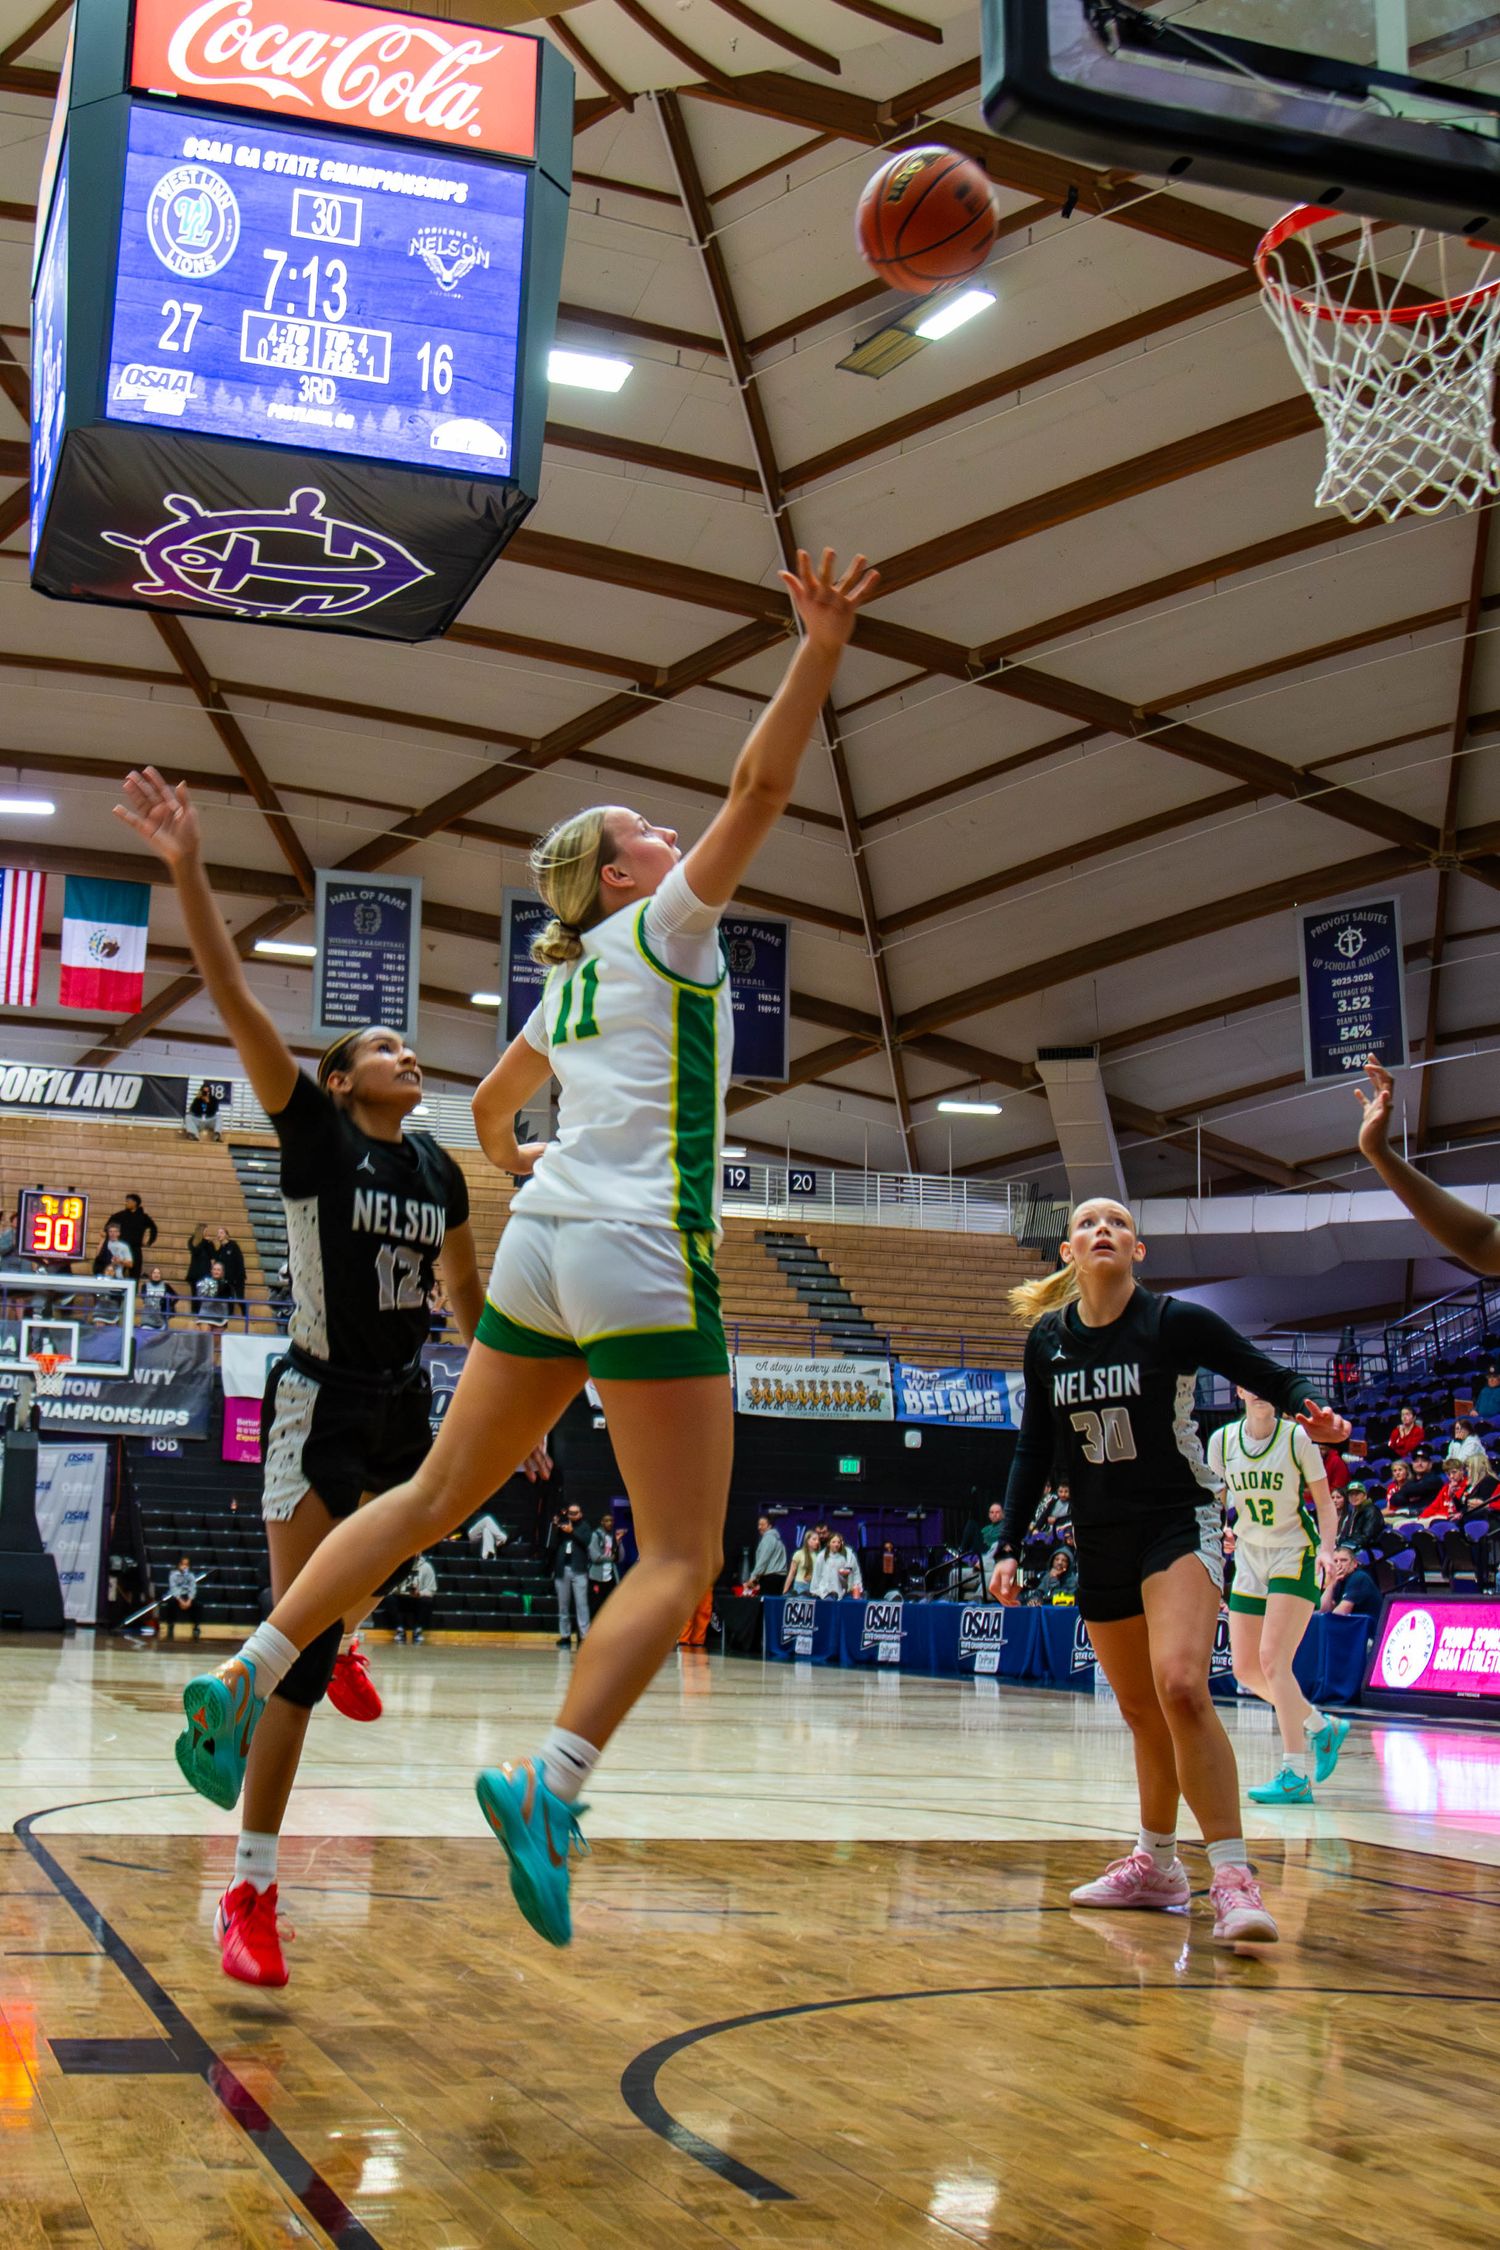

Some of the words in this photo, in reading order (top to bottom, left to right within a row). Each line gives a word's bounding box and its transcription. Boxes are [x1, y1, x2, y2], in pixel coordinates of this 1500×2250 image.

[168, 0, 504, 131] Coca-Cola
[263, 151, 320, 179] STATE
[311, 197, 342, 237] 30
[166, 248, 217, 273] LIONS
[408, 236, 490, 269] NELSON
[263, 248, 348, 322] 7:13
[158, 299, 203, 353] 27
[125, 368, 188, 391] OSAA
[417, 341, 453, 395] 16
[298, 375, 336, 405] 3RD
[329, 891, 357, 905] HALL
[360, 891, 375, 900] OF
[378, 892, 407, 911] FAME
[515, 909, 542, 922] HALL
[1311, 913, 1350, 939] PROVOST
[1352, 912, 1389, 926] SALUTES
[733, 926, 748, 935] OF
[752, 928, 782, 947] FAME
[1324, 959, 1357, 971] SCHOLAR
[1358, 945, 1391, 968] ATHLETES
[733, 978, 766, 987] LEYBALL
[552, 955, 600, 1046] 11
[1337, 995, 1371, 1013] 3.52
[1340, 1023, 1372, 1041] 54%
[1328, 1043, 1367, 1056] GRADUATION
[210, 1084, 225, 1100] 18
[728, 1168, 746, 1187] 19
[792, 1174, 812, 1191] 20
[41, 1195, 83, 1219] 7:13
[352, 1187, 446, 1248] NELSON
[33, 1216, 74, 1251] 30
[375, 1244, 424, 1311] 12
[770, 1362, 792, 1375] story
[805, 1364, 830, 1376] every
[831, 1362, 856, 1374] stitch
[901, 1367, 940, 1380] FIND
[906, 1379, 966, 1390] WHERE
[967, 1373, 992, 1390] YOU
[1054, 1362, 1141, 1407] NELSON
[37, 1402, 190, 1426] HAMPIONSHIPS
[903, 1389, 1001, 1415] BELONG
[1069, 1406, 1137, 1464] 30
[1230, 1471, 1284, 1491] LIONS
[1245, 1498, 1274, 1525] 12
[785, 1603, 814, 1626] OSAA
[866, 1605, 900, 1631] OSAA
[962, 1611, 1003, 1639] OSAA
[1212, 1656, 1227, 1665] STATE
